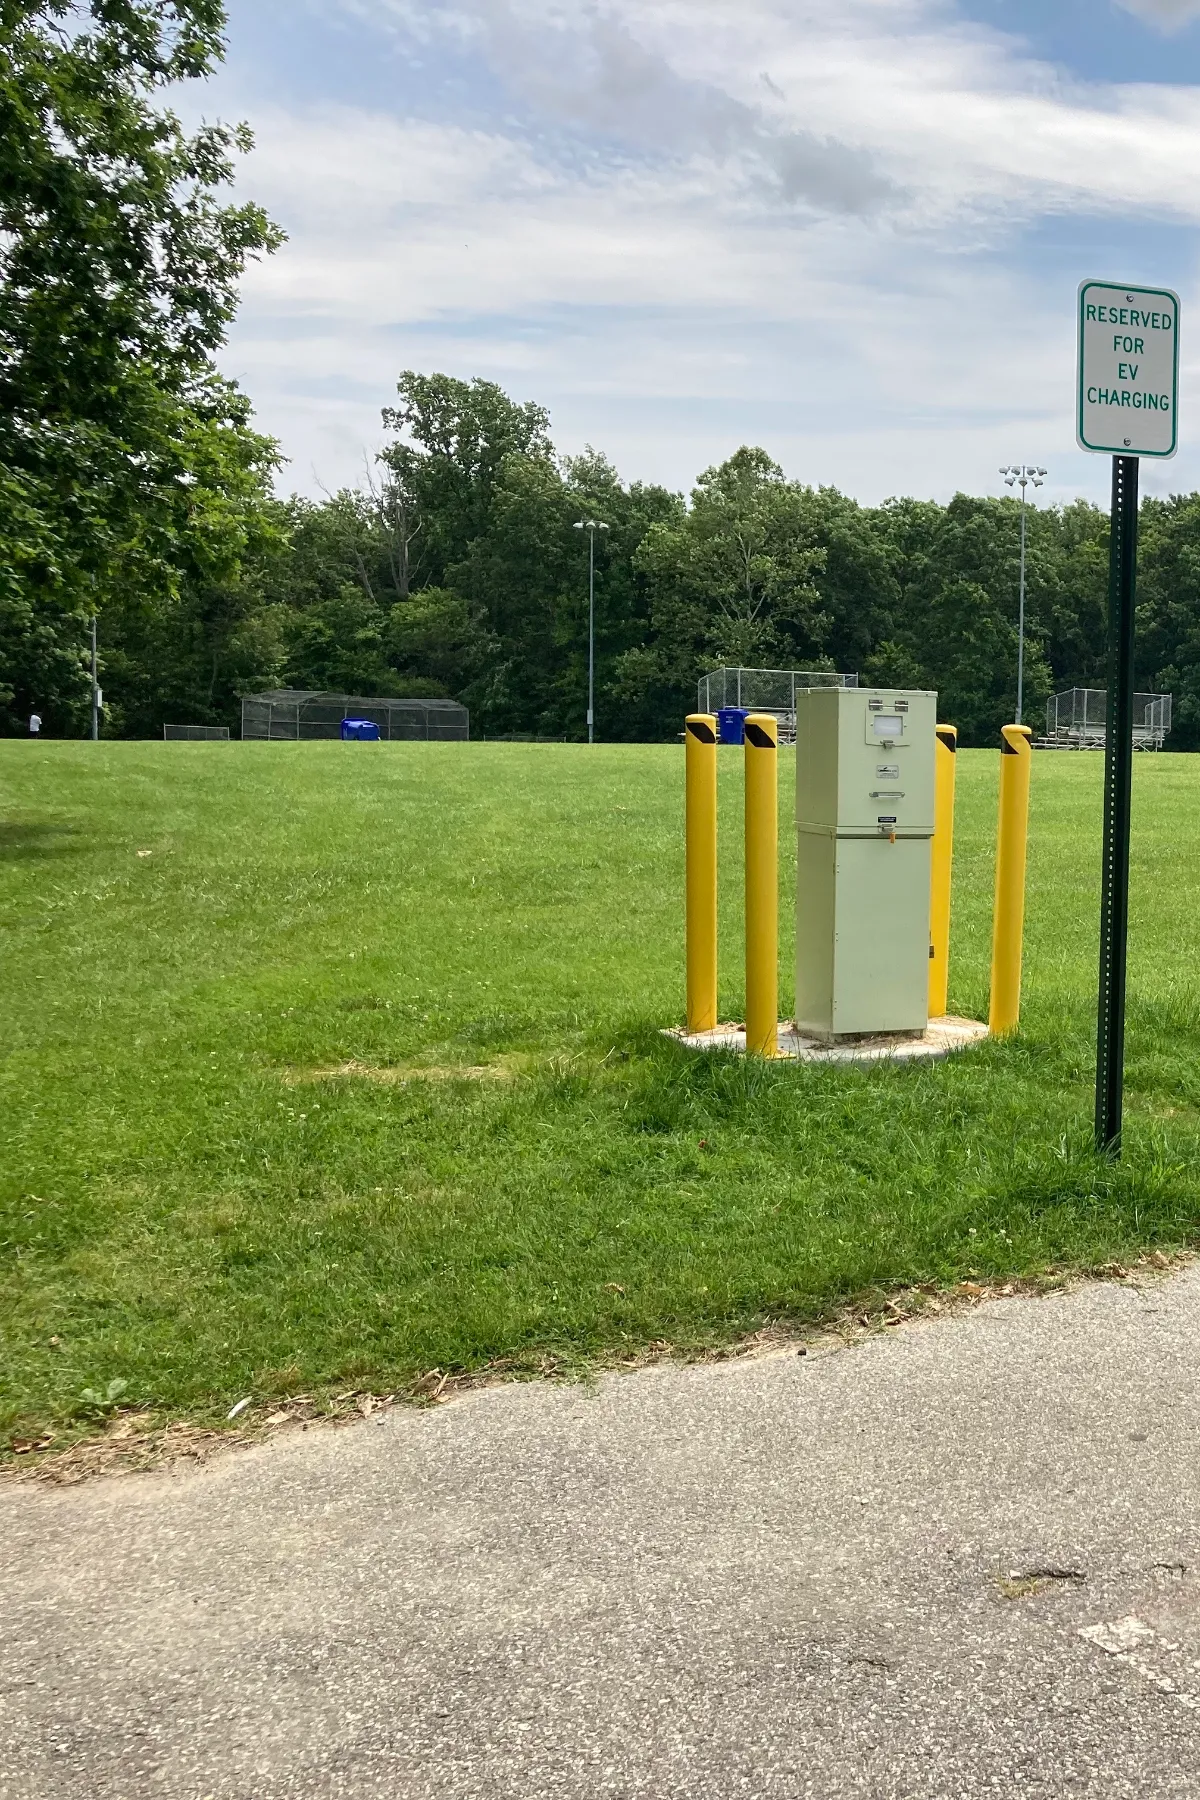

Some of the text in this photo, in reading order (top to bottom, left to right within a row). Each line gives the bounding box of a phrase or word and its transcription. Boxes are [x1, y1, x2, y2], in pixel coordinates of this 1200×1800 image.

[1087, 304, 1172, 330] RESERVED
[1113, 336, 1144, 354] FOR
[1118, 363, 1138, 380] EV
[1087, 387, 1169, 411] CHARGING
